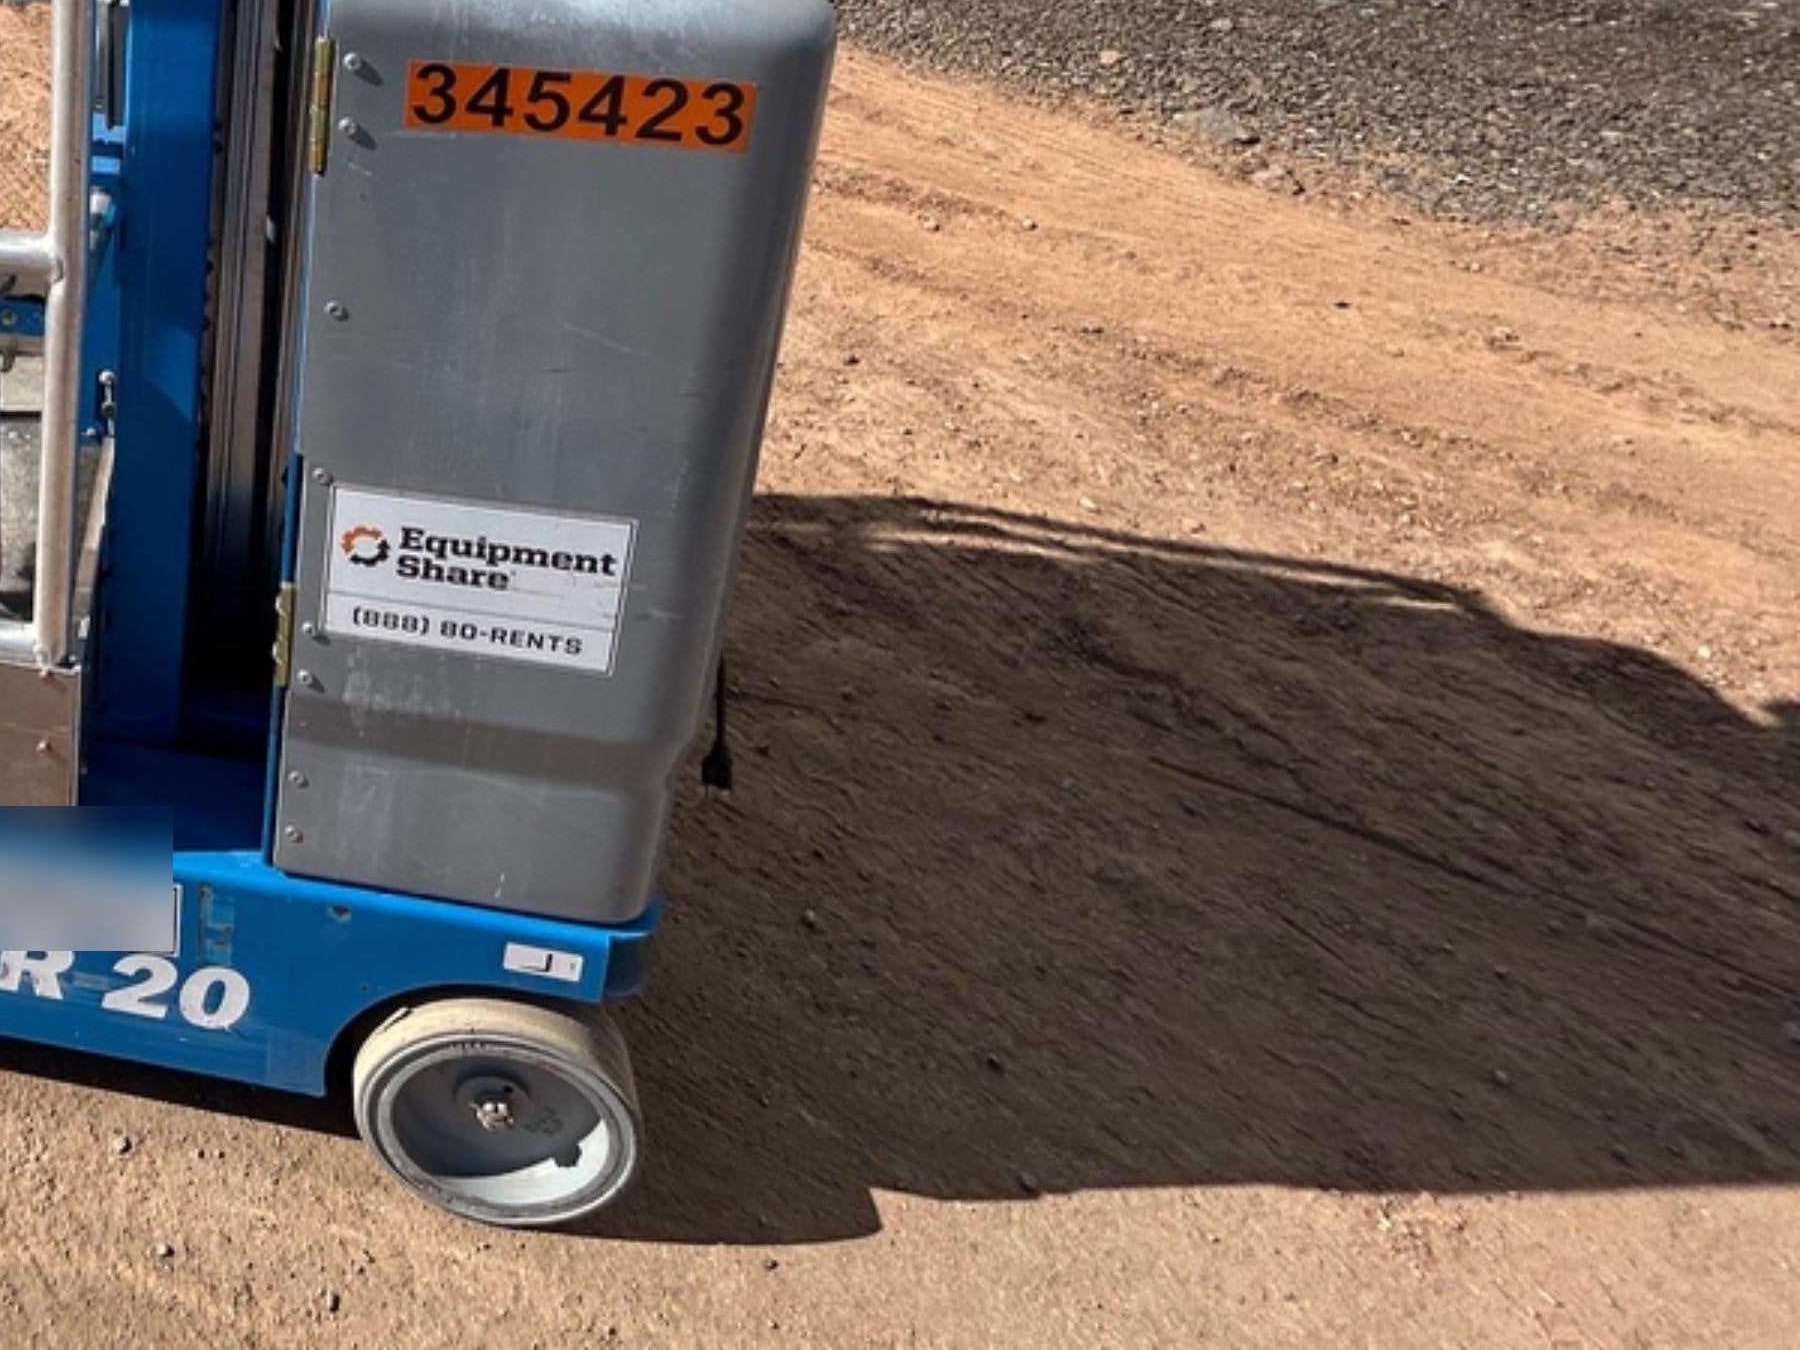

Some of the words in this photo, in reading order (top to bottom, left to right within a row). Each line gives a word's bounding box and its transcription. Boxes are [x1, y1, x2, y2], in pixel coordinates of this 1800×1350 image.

[413, 63, 746, 146] 345423
[396, 555, 510, 591] Share
[398, 526, 618, 576] Equipment
[352, 605, 430, 636] (888)
[440, 619, 584, 655] 80-RENTS
[101, 952, 251, 1031] 20
